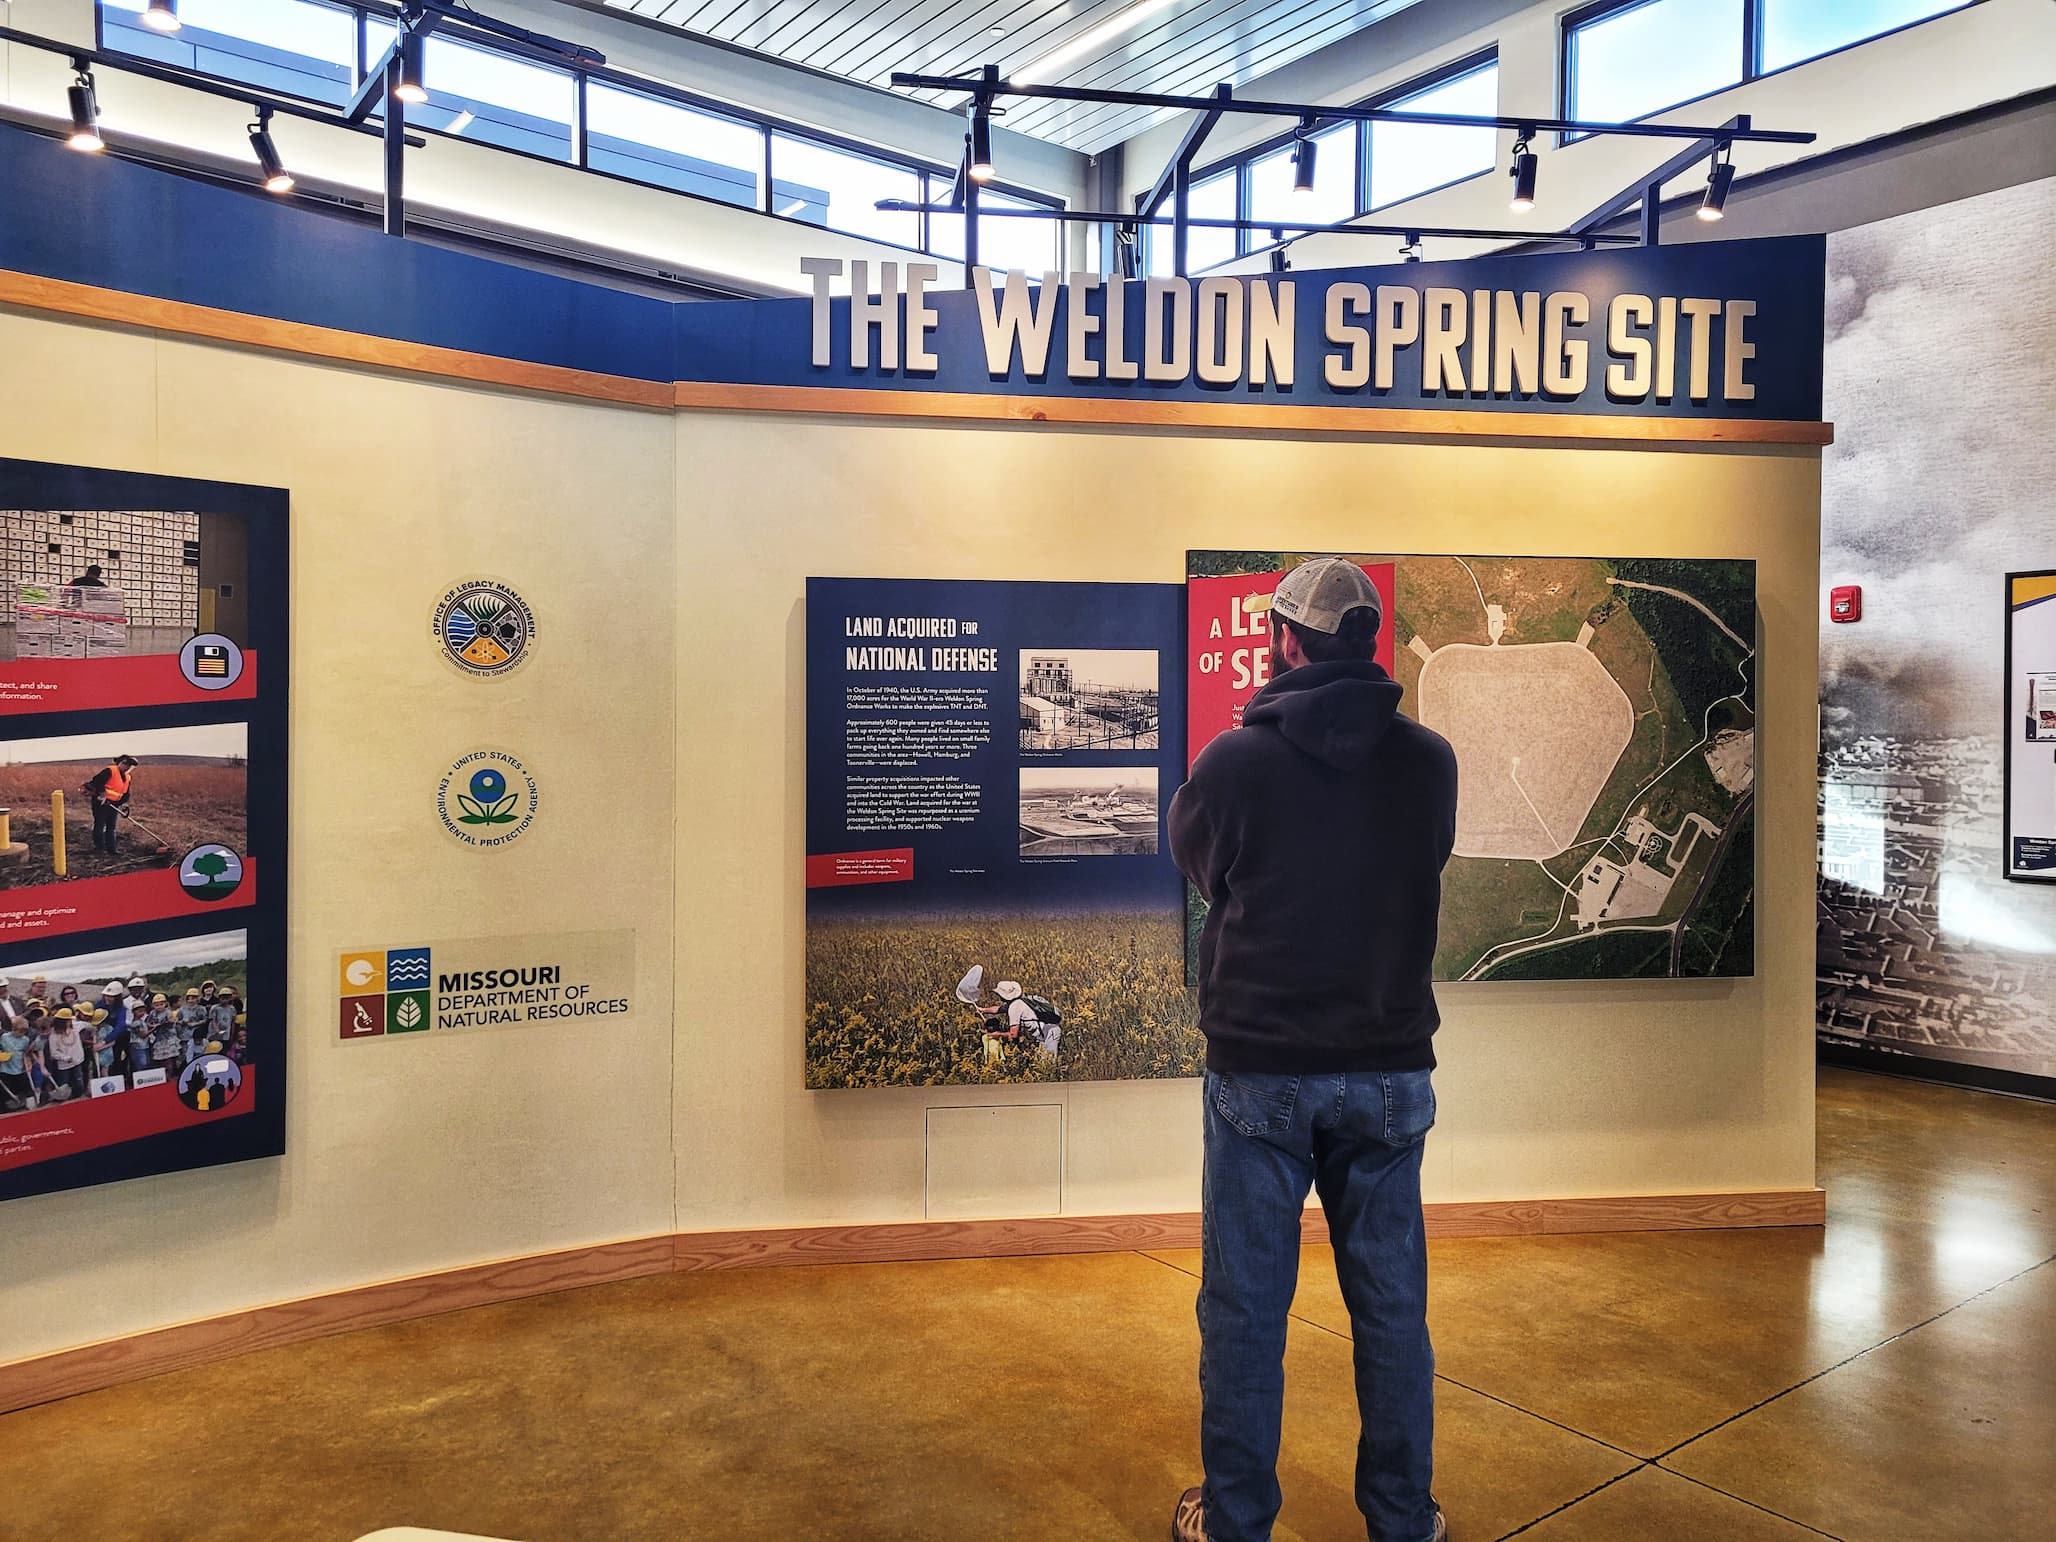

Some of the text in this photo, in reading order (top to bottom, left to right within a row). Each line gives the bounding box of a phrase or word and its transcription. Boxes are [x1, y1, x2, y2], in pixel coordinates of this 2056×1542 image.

[801, 258, 1756, 402] THE WELDON SPRING SITE
[433, 580, 536, 639] OFFICE OF LEGACY MANAGEMENT
[846, 617, 978, 639] LAND ACQUIRED FOR
[1209, 617, 1223, 638] A
[441, 648, 481, 676] Commitment
[492, 650, 529, 676] Stewardship
[846, 647, 998, 672] NATIONAL DEFENSE
[1199, 651, 1223, 674] OF
[453, 752, 522, 770] UNITED STATES
[437, 777, 538, 846] ENVIRONMENTAL PROTECTION AGENCY
[44, 908, 76, 916] optimize
[439, 966, 560, 993] MISSOURI
[438, 985, 589, 1011] DEPARTMENT OF
[438, 998, 628, 1029] NATURAL RESOURCES
